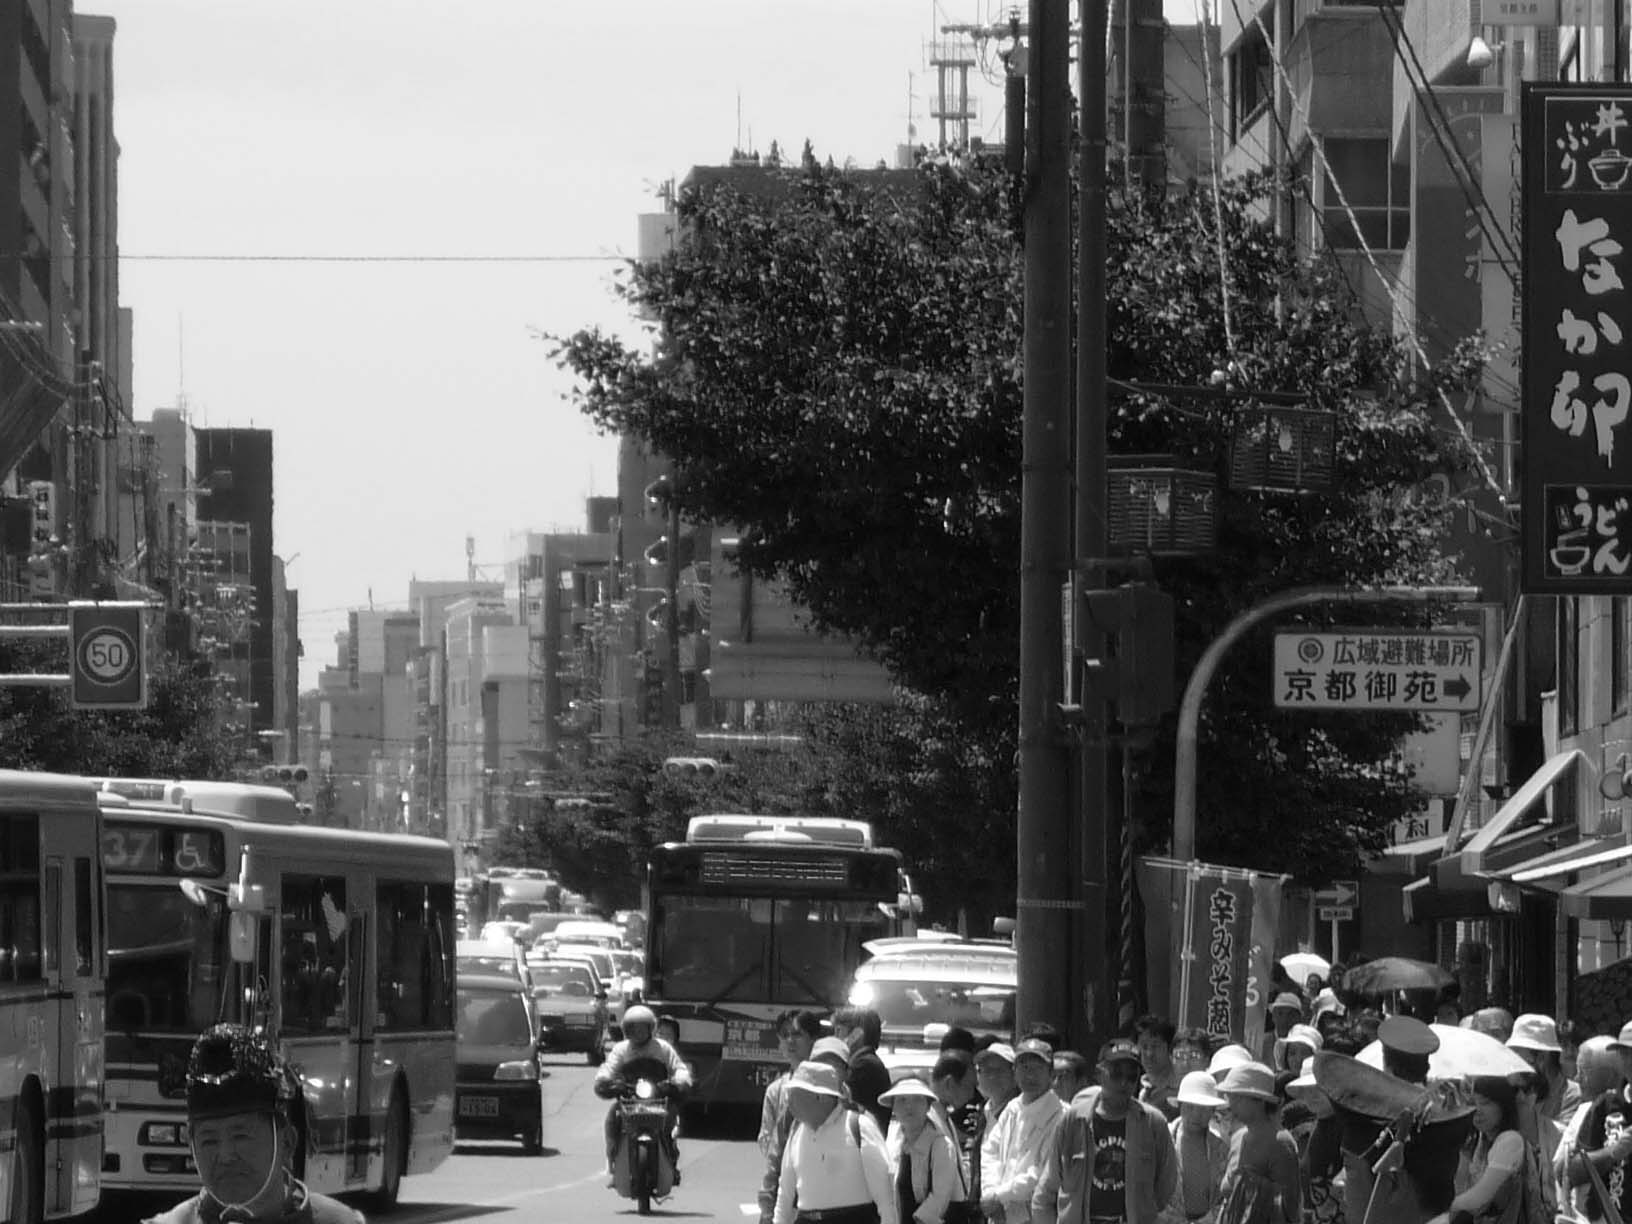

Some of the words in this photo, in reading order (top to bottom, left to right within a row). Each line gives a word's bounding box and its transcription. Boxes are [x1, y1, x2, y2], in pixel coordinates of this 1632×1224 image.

[1550, 208, 1632, 470] なか卯
[91, 642, 124, 668] 50
[1332, 637, 1475, 667] 広域避難場所
[1282, 668, 1439, 703] 京都御苑
